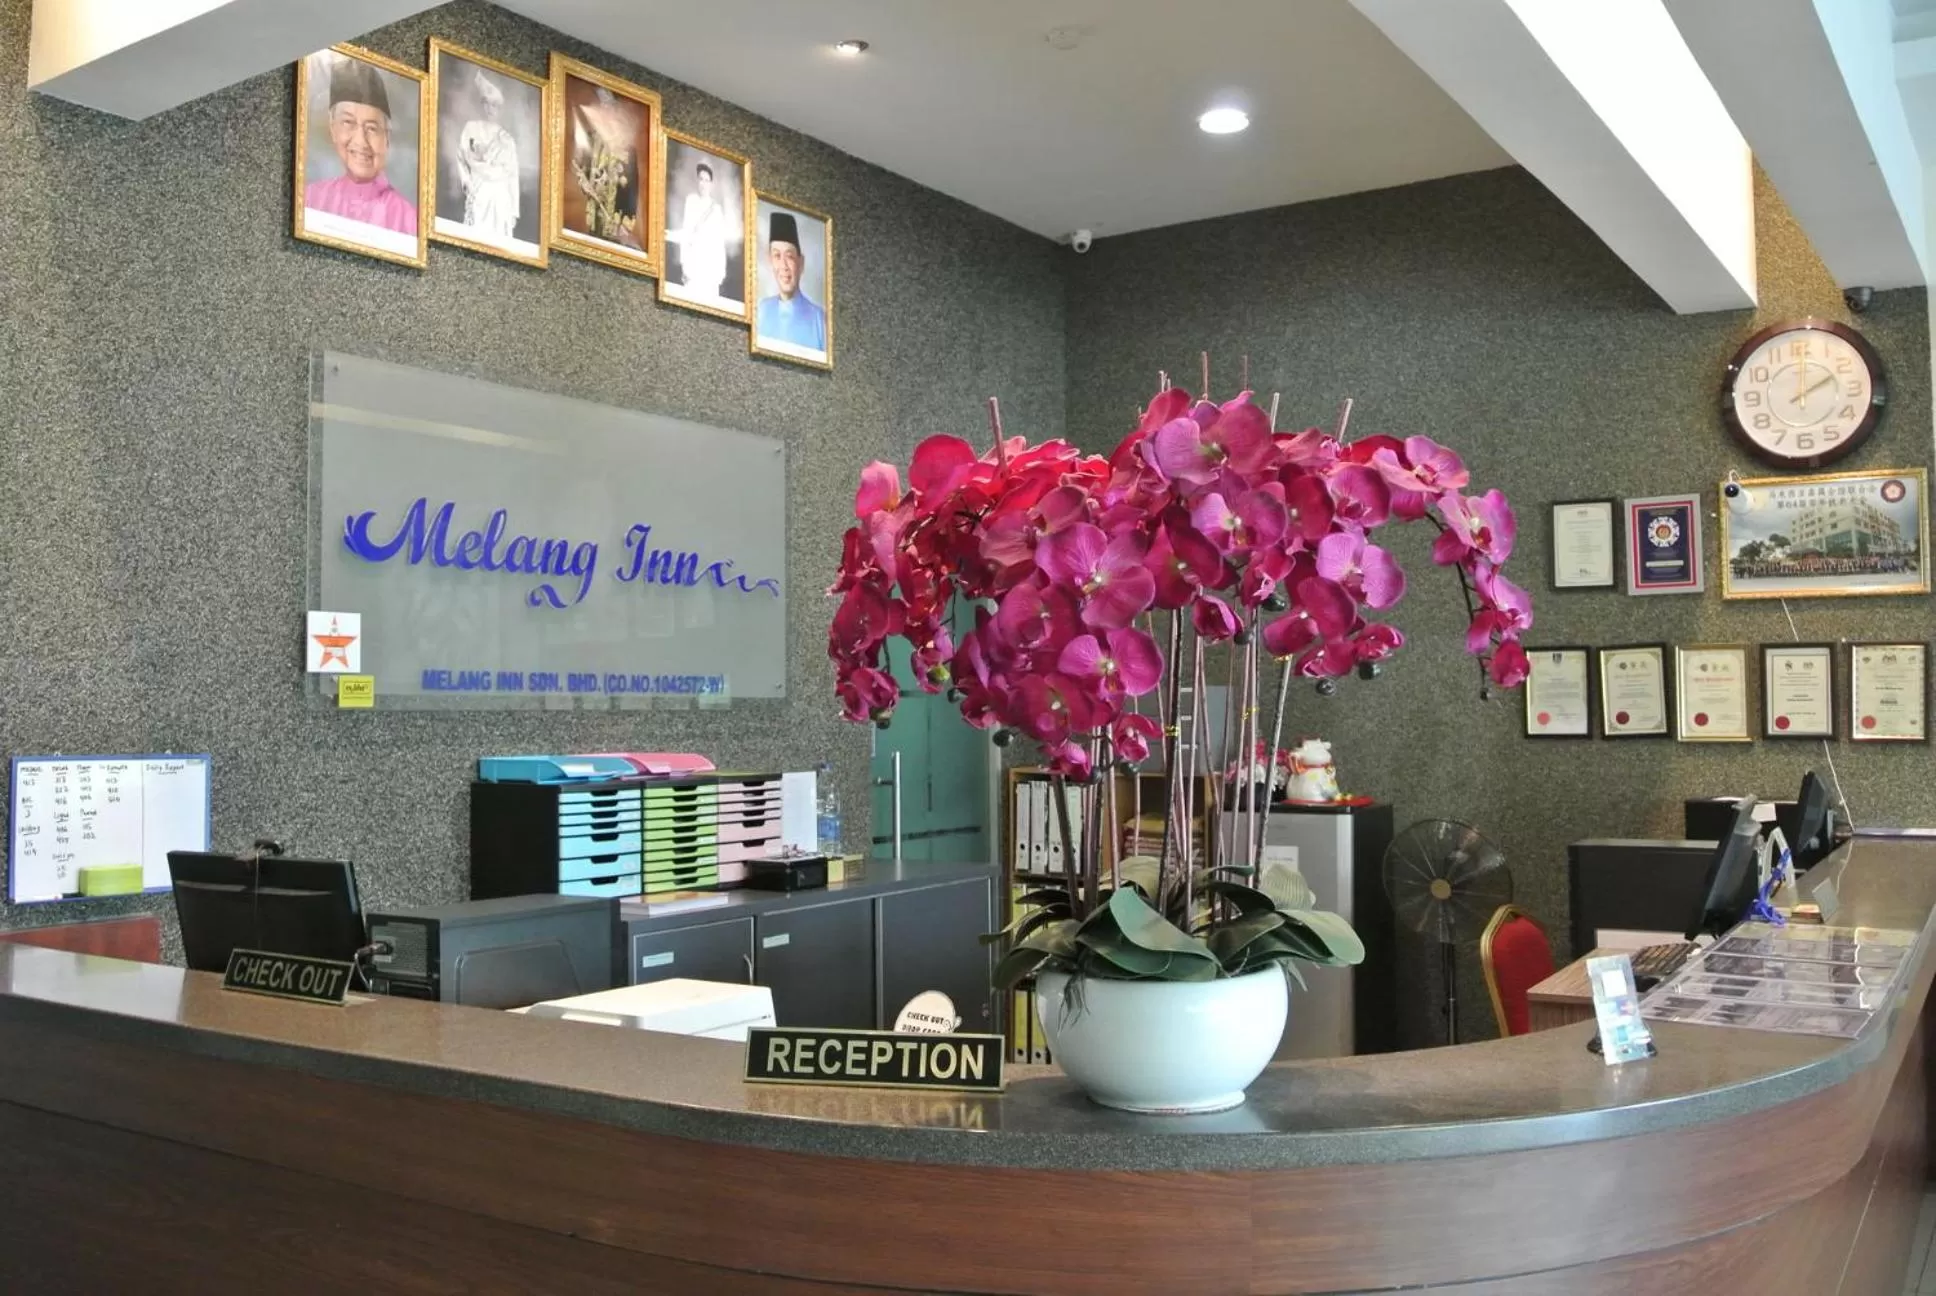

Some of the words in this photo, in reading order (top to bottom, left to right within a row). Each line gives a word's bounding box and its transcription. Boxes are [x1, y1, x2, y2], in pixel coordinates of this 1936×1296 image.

[1769, 347, 1781, 365] 11
[1836, 357, 1852, 374] 2
[1749, 366, 1768, 383] 10
[1847, 381, 1863, 397] 3
[1744, 390, 1761, 408] 9
[1838, 404, 1856, 420] 4
[1753, 412, 1771, 430] 8
[1771, 429, 1787, 446] 7
[1797, 433, 1815, 449] 6
[1824, 426, 1840, 441] 5
[344, 497, 598, 608] Melang
[421, 669, 492, 691] MELANG
[496, 671, 525, 692] INN
[528, 672, 563, 693] SDN.
[567, 672, 600, 693] BHD.
[234, 956, 299, 989] CHECK
[299, 964, 343, 997] OUT
[907, 1011, 930, 1022] CHECK
[931, 1016, 944, 1024] OUT
[766, 1037, 984, 1080] RECEPTION
